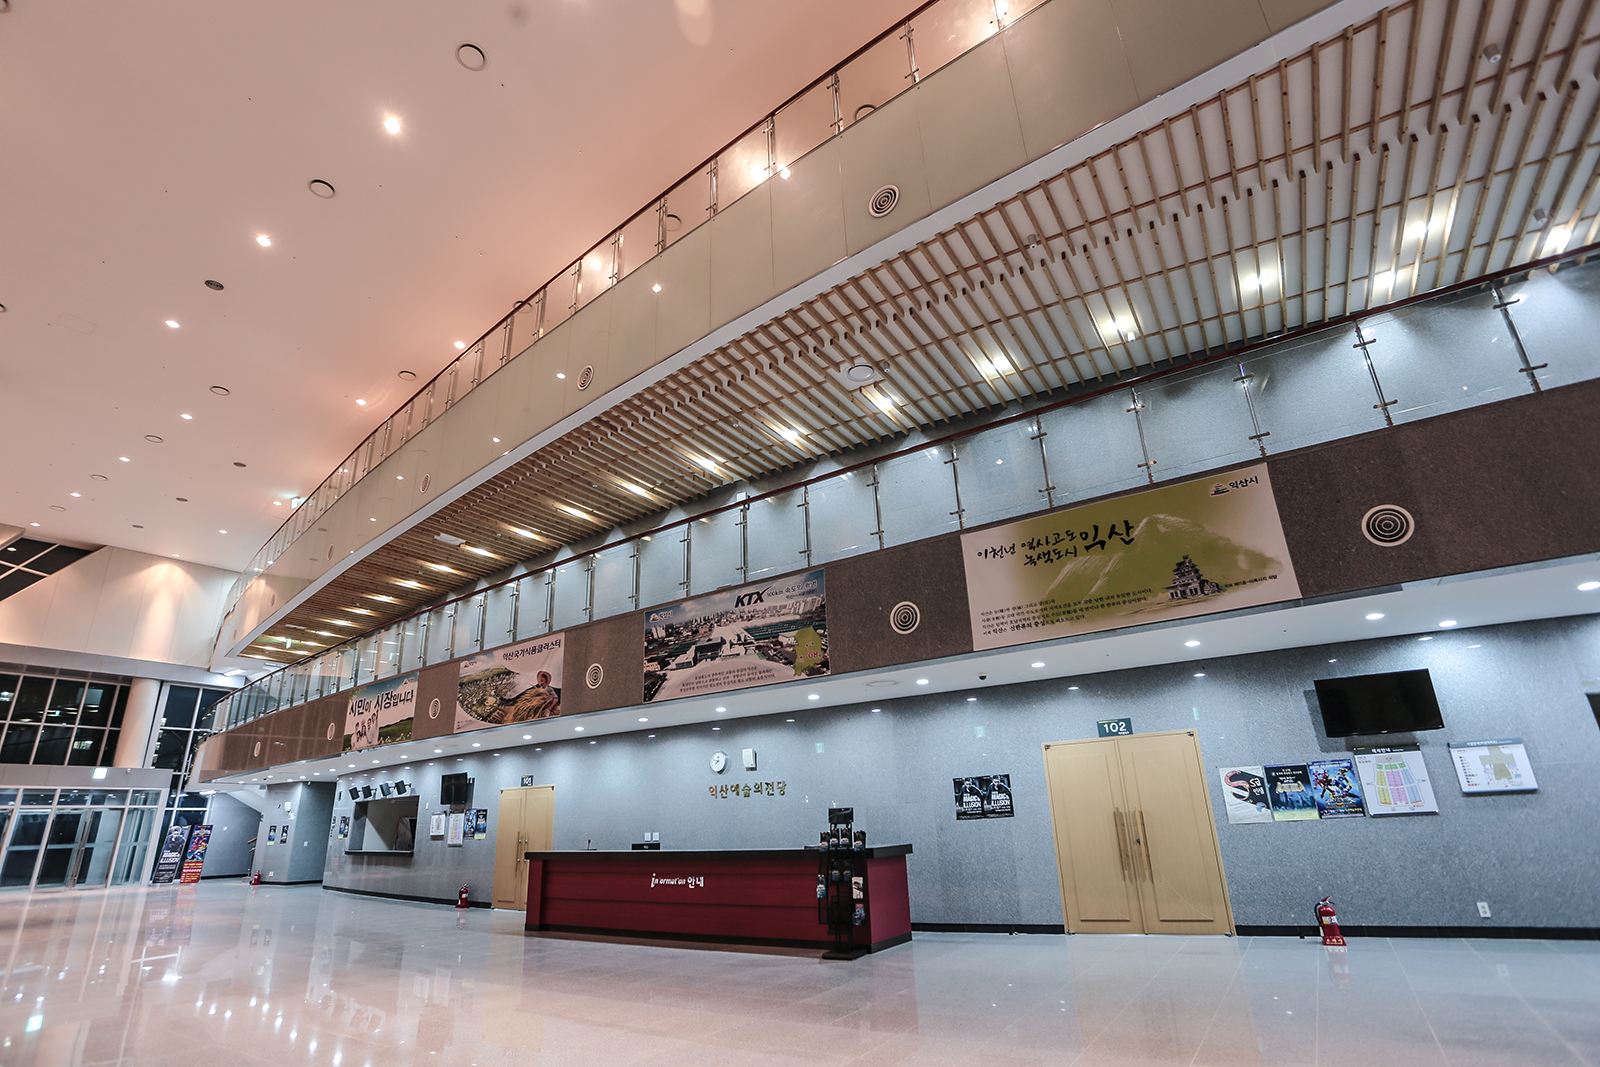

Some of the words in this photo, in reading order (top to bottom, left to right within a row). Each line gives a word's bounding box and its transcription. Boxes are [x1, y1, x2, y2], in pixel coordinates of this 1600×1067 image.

[1229, 476, 1259, 489] 익산시
[977, 543, 1016, 560] 이천년
[1021, 530, 1077, 551] 역사고도
[1080, 520, 1135, 552] 익산
[1024, 545, 1078, 566] 녹색도시
[735, 585, 773, 608] KTX
[349, 698, 372, 717] 시민이
[374, 689, 414, 711] 시장입니다
[1104, 721, 1127, 733] 102
[708, 780, 787, 799] 익산예술의전당
[687, 876, 704, 889] 안내
